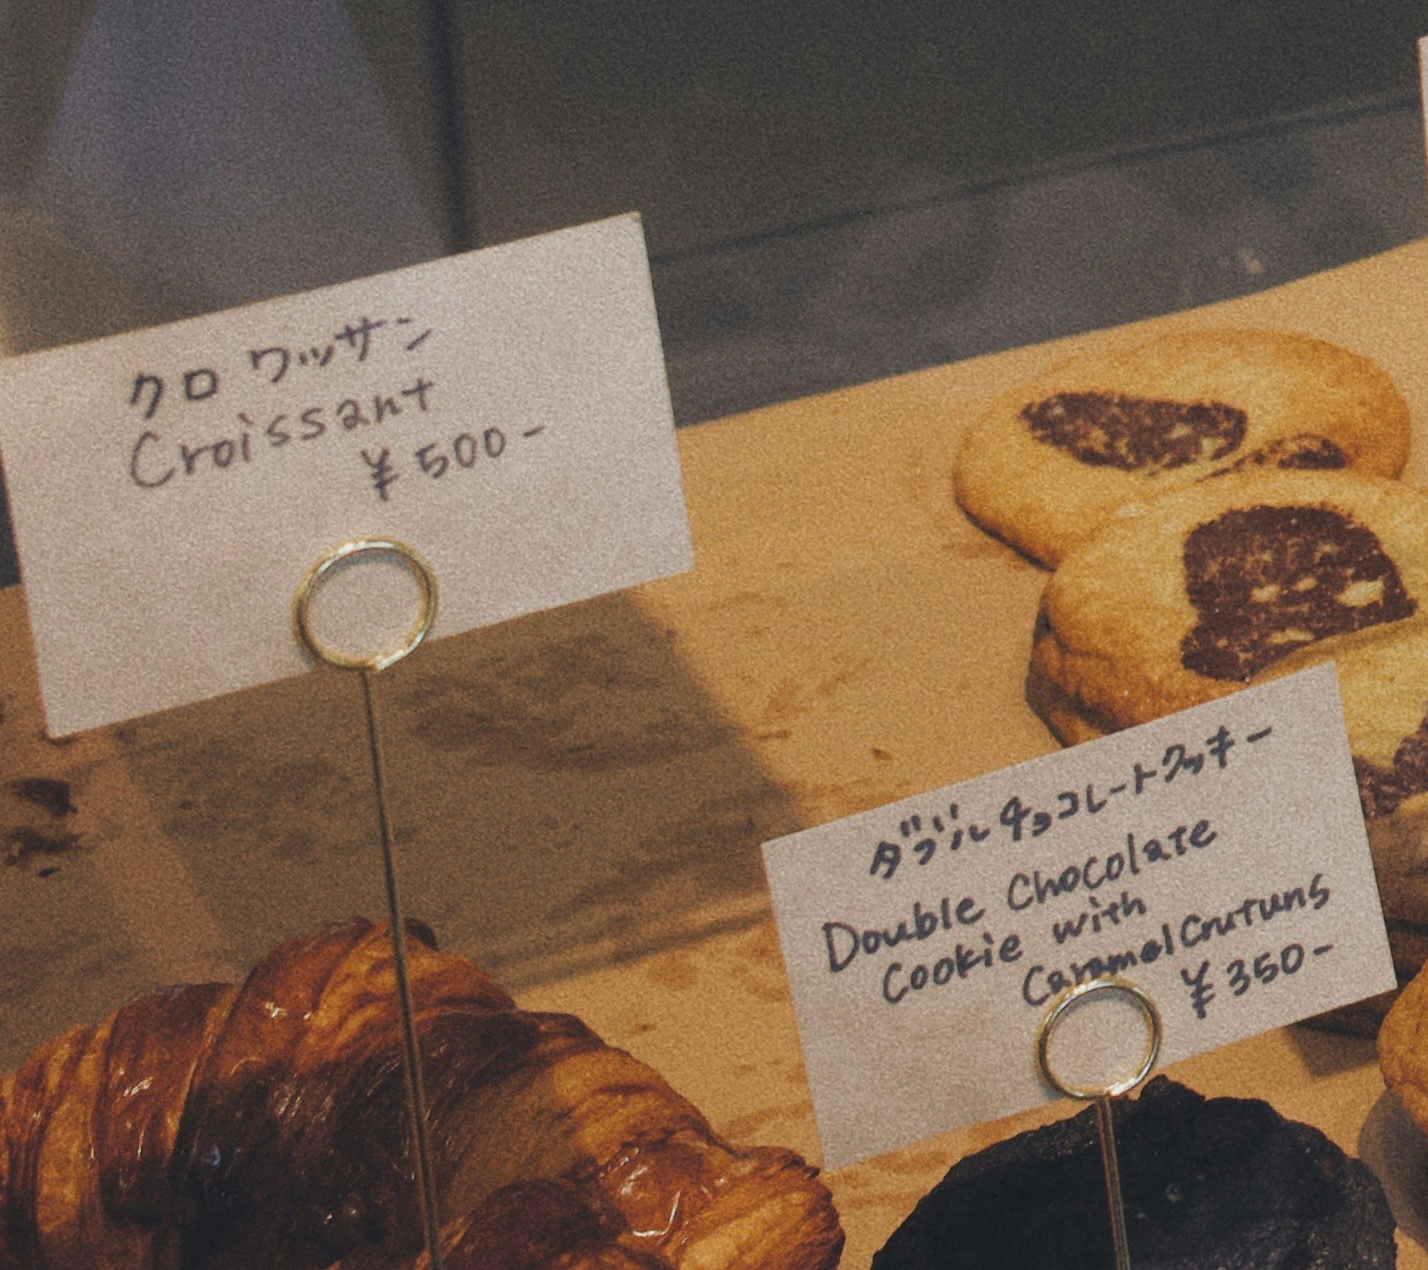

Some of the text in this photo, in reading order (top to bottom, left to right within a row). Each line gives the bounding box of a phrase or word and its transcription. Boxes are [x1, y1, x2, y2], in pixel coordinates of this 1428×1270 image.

[128, 315, 435, 421] クロワッサン
[129, 375, 436, 490] Croissant
[868, 724, 1274, 880] ダブルチョコレートクッキー
[820, 818, 1219, 974] Double Chocolate
[881, 894, 1147, 1006] Cookie with
[1021, 924, 1176, 1008] Caramel
